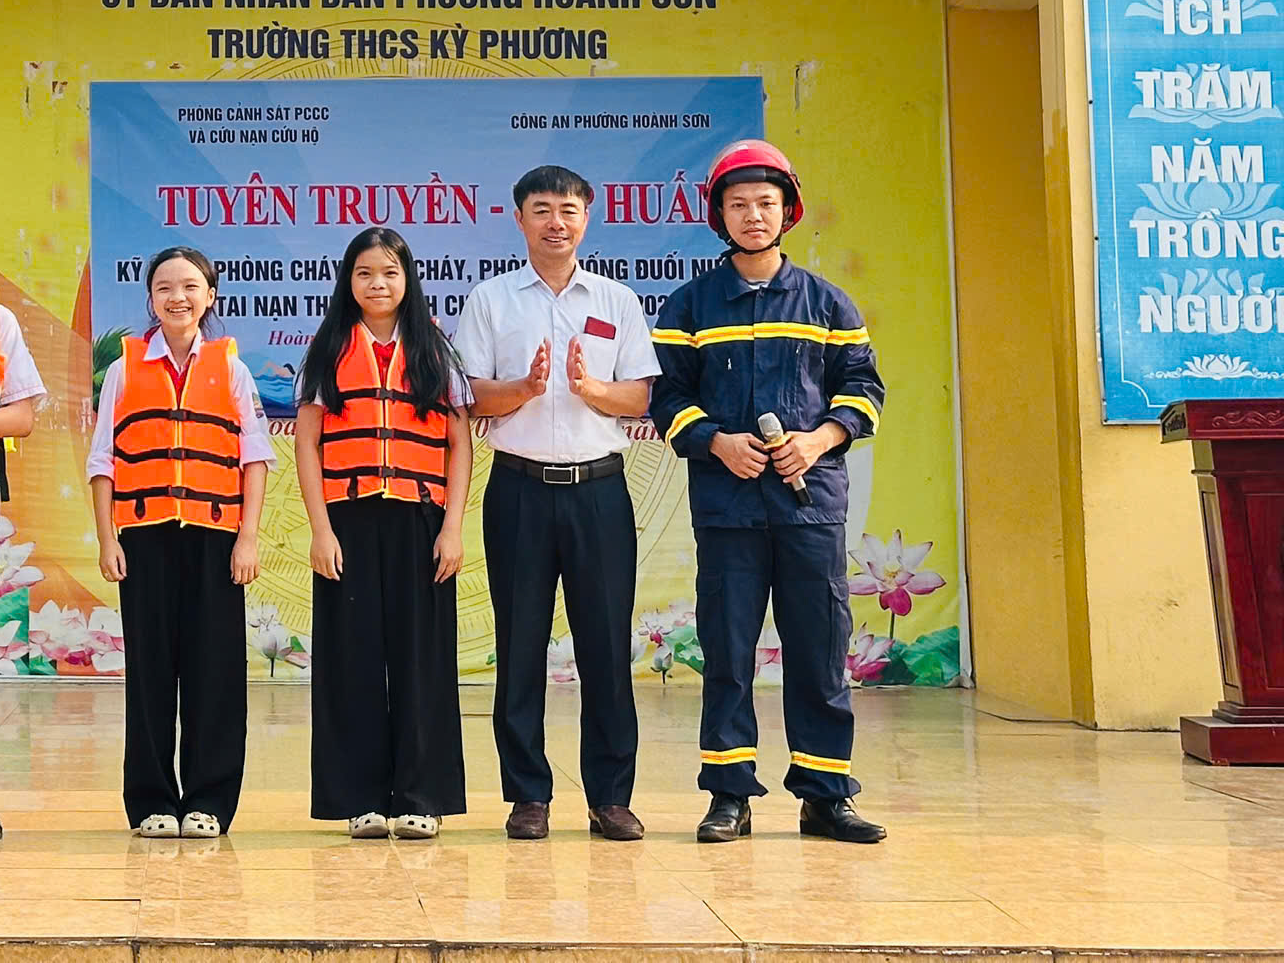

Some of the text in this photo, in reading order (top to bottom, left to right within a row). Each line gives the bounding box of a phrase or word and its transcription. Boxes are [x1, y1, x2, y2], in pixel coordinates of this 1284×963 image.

[207, 21, 608, 59] TRƯỜNG THCS KỲ PHƯƠNG
[1135, 63, 1272, 110] TRĂM
[227, 102, 262, 121] CẢNH
[295, 107, 330, 121] PCCC
[551, 115, 570, 129] AN
[633, 112, 678, 129] HOÀNH
[683, 113, 710, 129] SƠN
[189, 127, 205, 143] VÀ
[209, 126, 235, 143] CỨU
[240, 130, 267, 146] NẠN
[272, 125, 297, 143] CỨU
[1151, 137, 1264, 183] NĂM
[157, 171, 297, 226] TUYÊN
[308, 171, 479, 225] TRUYỀN
[1129, 208, 1284, 258] TRỒNG
[117, 256, 143, 282] KỸ
[214, 255, 283, 281] PHÒNG
[634, 251, 685, 280] ĐUỐI
[216, 295, 247, 317] TAI
[254, 295, 297, 322] NẠN
